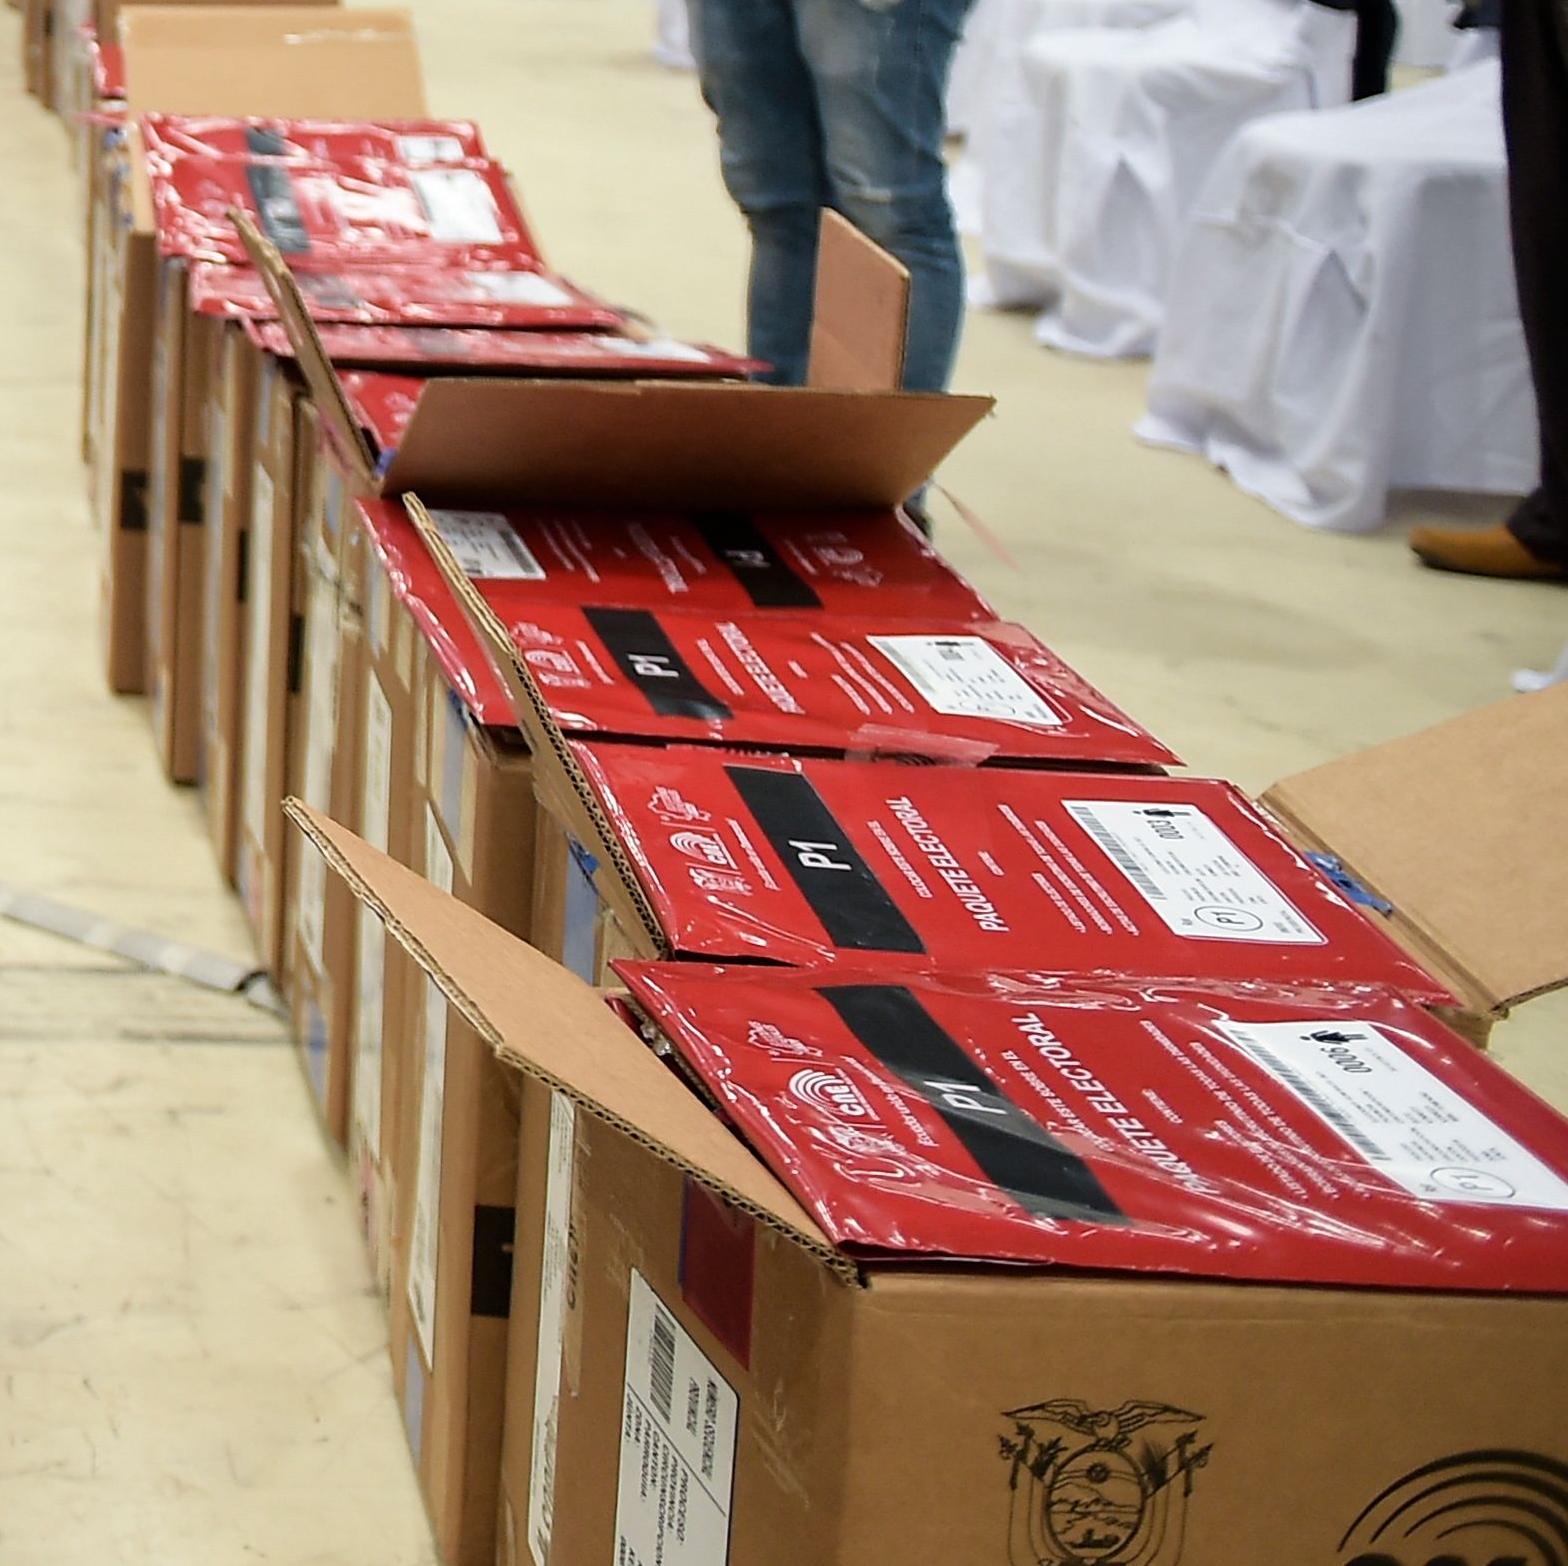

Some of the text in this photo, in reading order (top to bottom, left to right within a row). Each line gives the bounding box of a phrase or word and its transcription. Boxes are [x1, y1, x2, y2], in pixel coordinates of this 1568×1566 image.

[628, 653, 680, 678] P1
[883, 796, 960, 867] ELECTORAL
[788, 839, 852, 871] P1
[936, 867, 1010, 931] PAQUETE
[1210, 911, 1246, 925] P1
[1009, 1012, 1129, 1112] ELECTORAL
[1320, 1046, 1372, 1074] 0006
[826, 1083, 866, 1117] CNE
[923, 1079, 1008, 1116] P1
[1103, 1116, 1221, 1194] PAQUETE
[1451, 1173, 1494, 1192] P1
